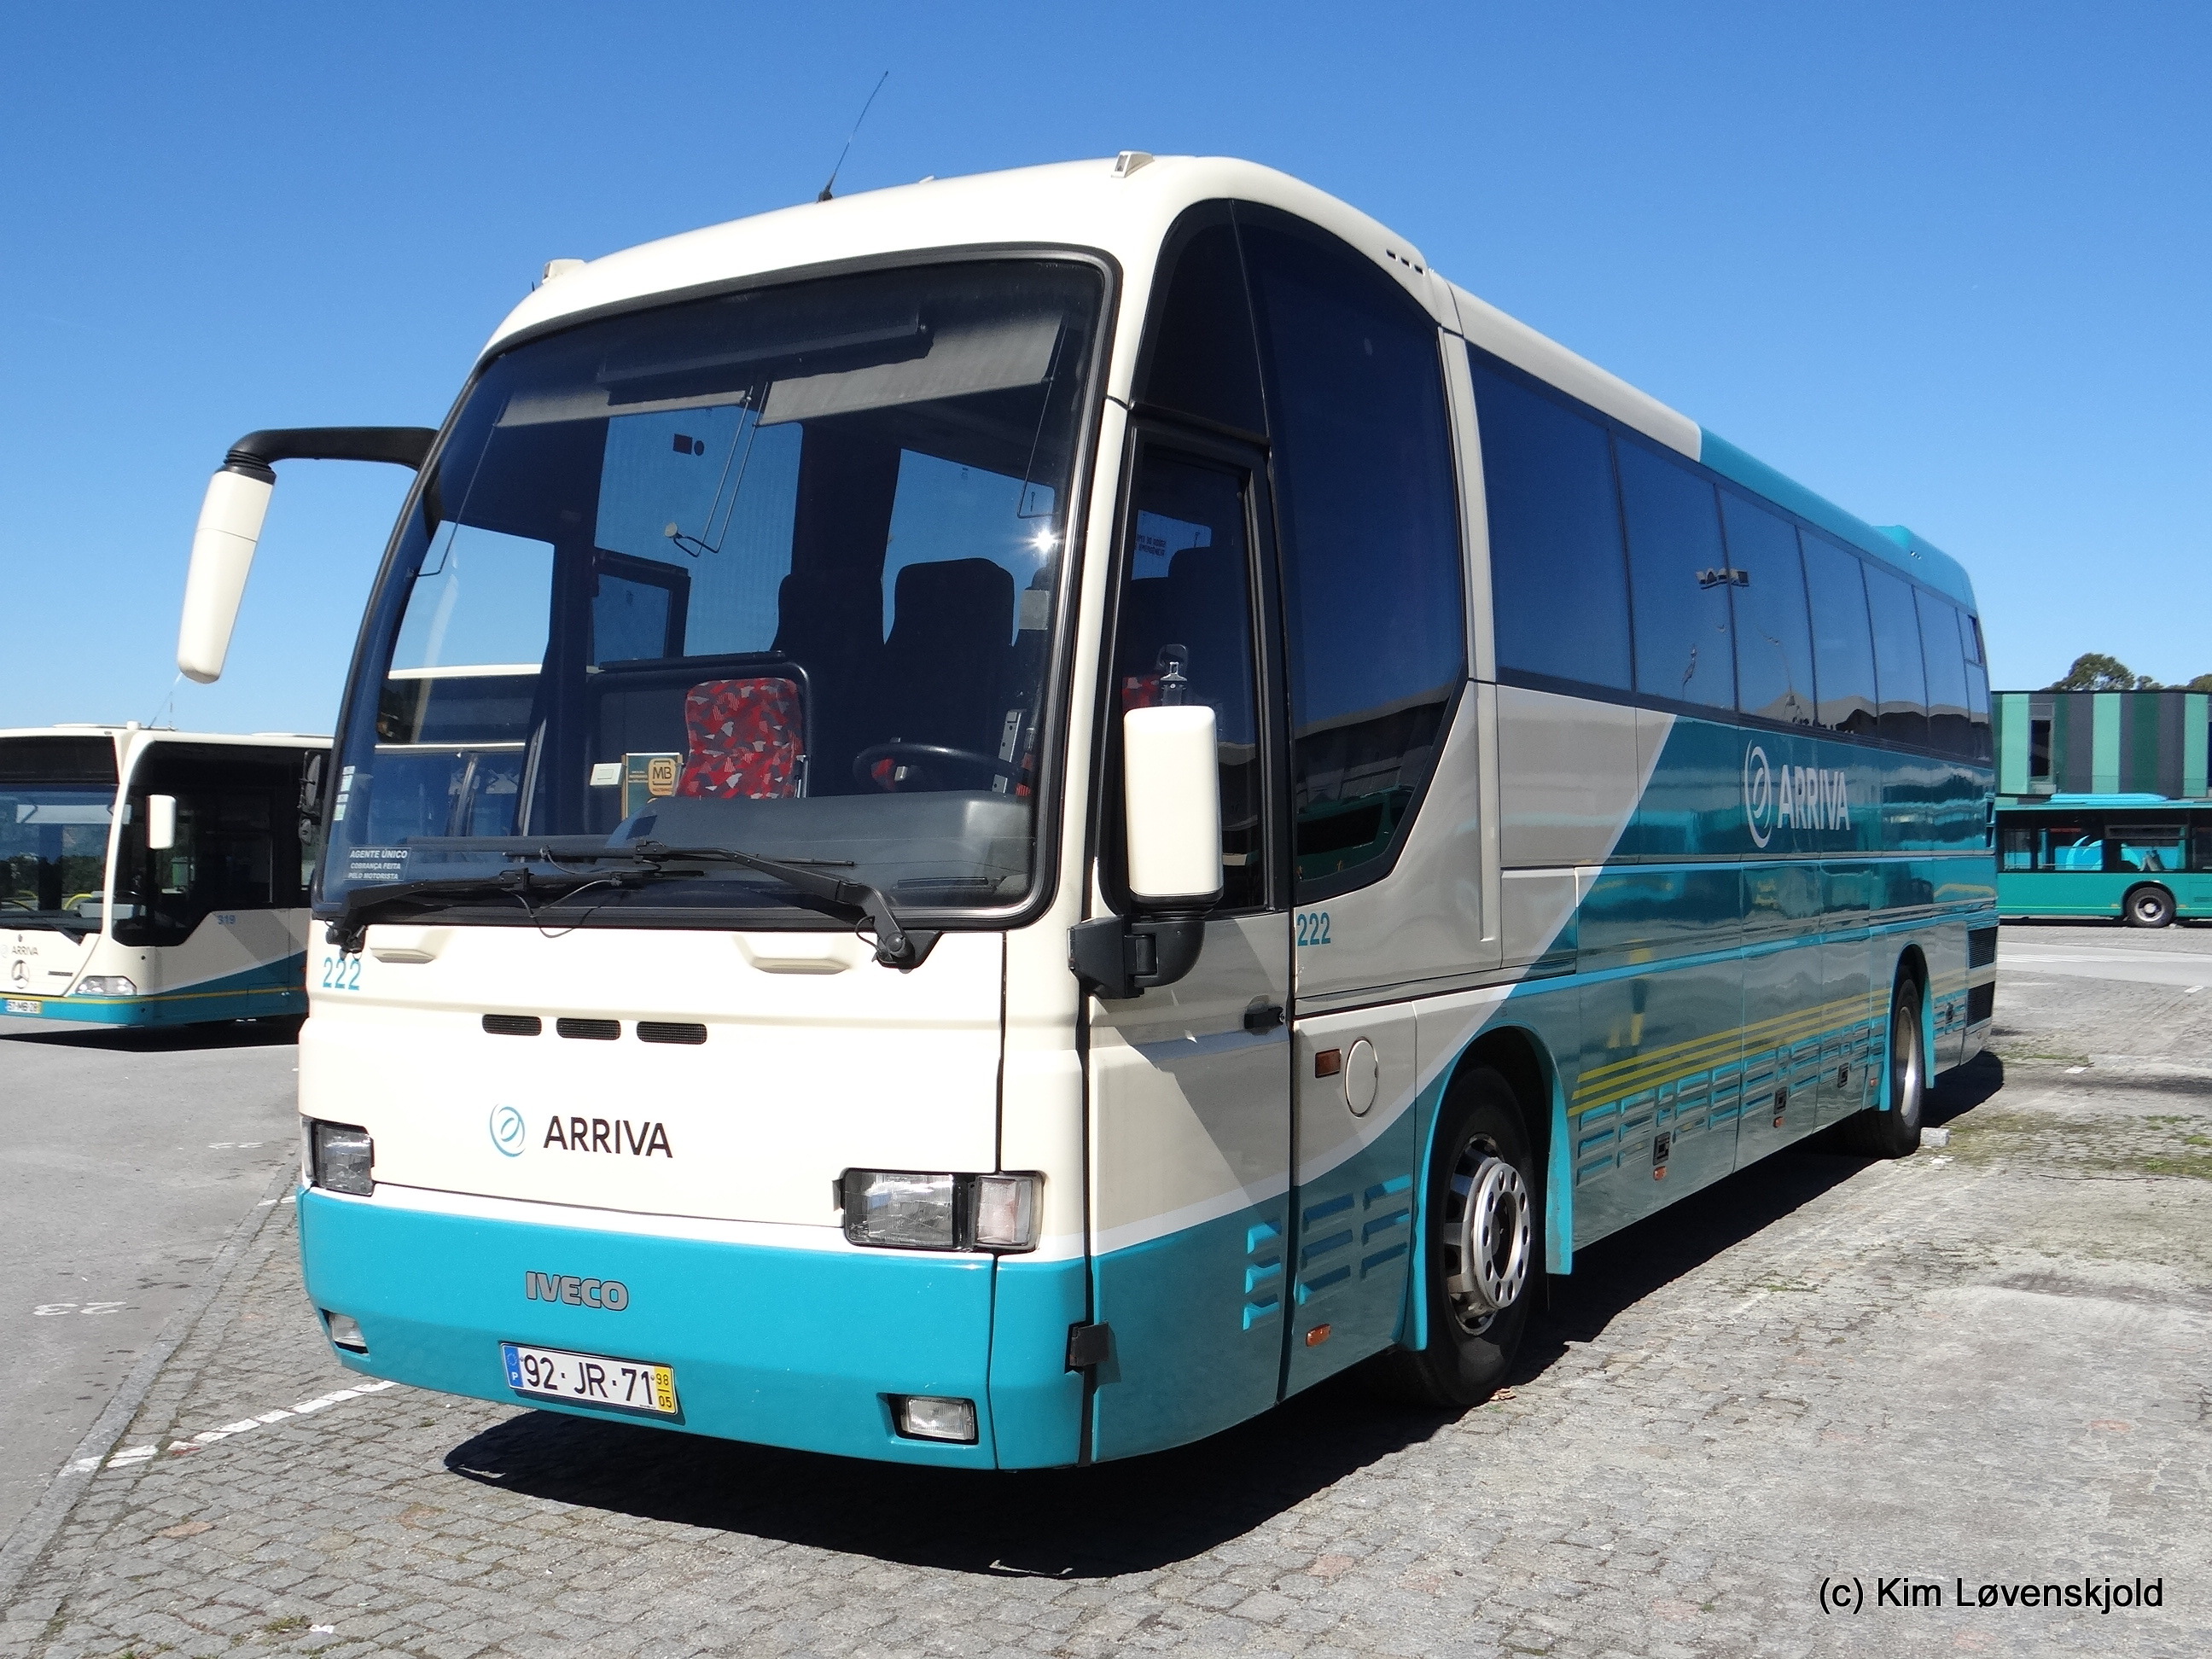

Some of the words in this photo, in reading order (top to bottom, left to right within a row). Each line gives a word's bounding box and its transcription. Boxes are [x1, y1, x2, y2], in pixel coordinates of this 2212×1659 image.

[652, 766, 672, 780] MB
[1777, 764, 1851, 831] ARRIVA
[349, 850, 381, 859] AGENTE
[381, 848, 408, 859] ÚNICO
[1297, 911, 1331, 946] 222
[12, 946, 39, 956] ARRIVA
[323, 957, 362, 991] 222
[543, 1115, 673, 1159] ARRIVA
[526, 1271, 629, 1312] IVECO
[512, 1372, 518, 1381] P
[655, 1372, 670, 1386] 98
[658, 1394, 672, 1408] 05
